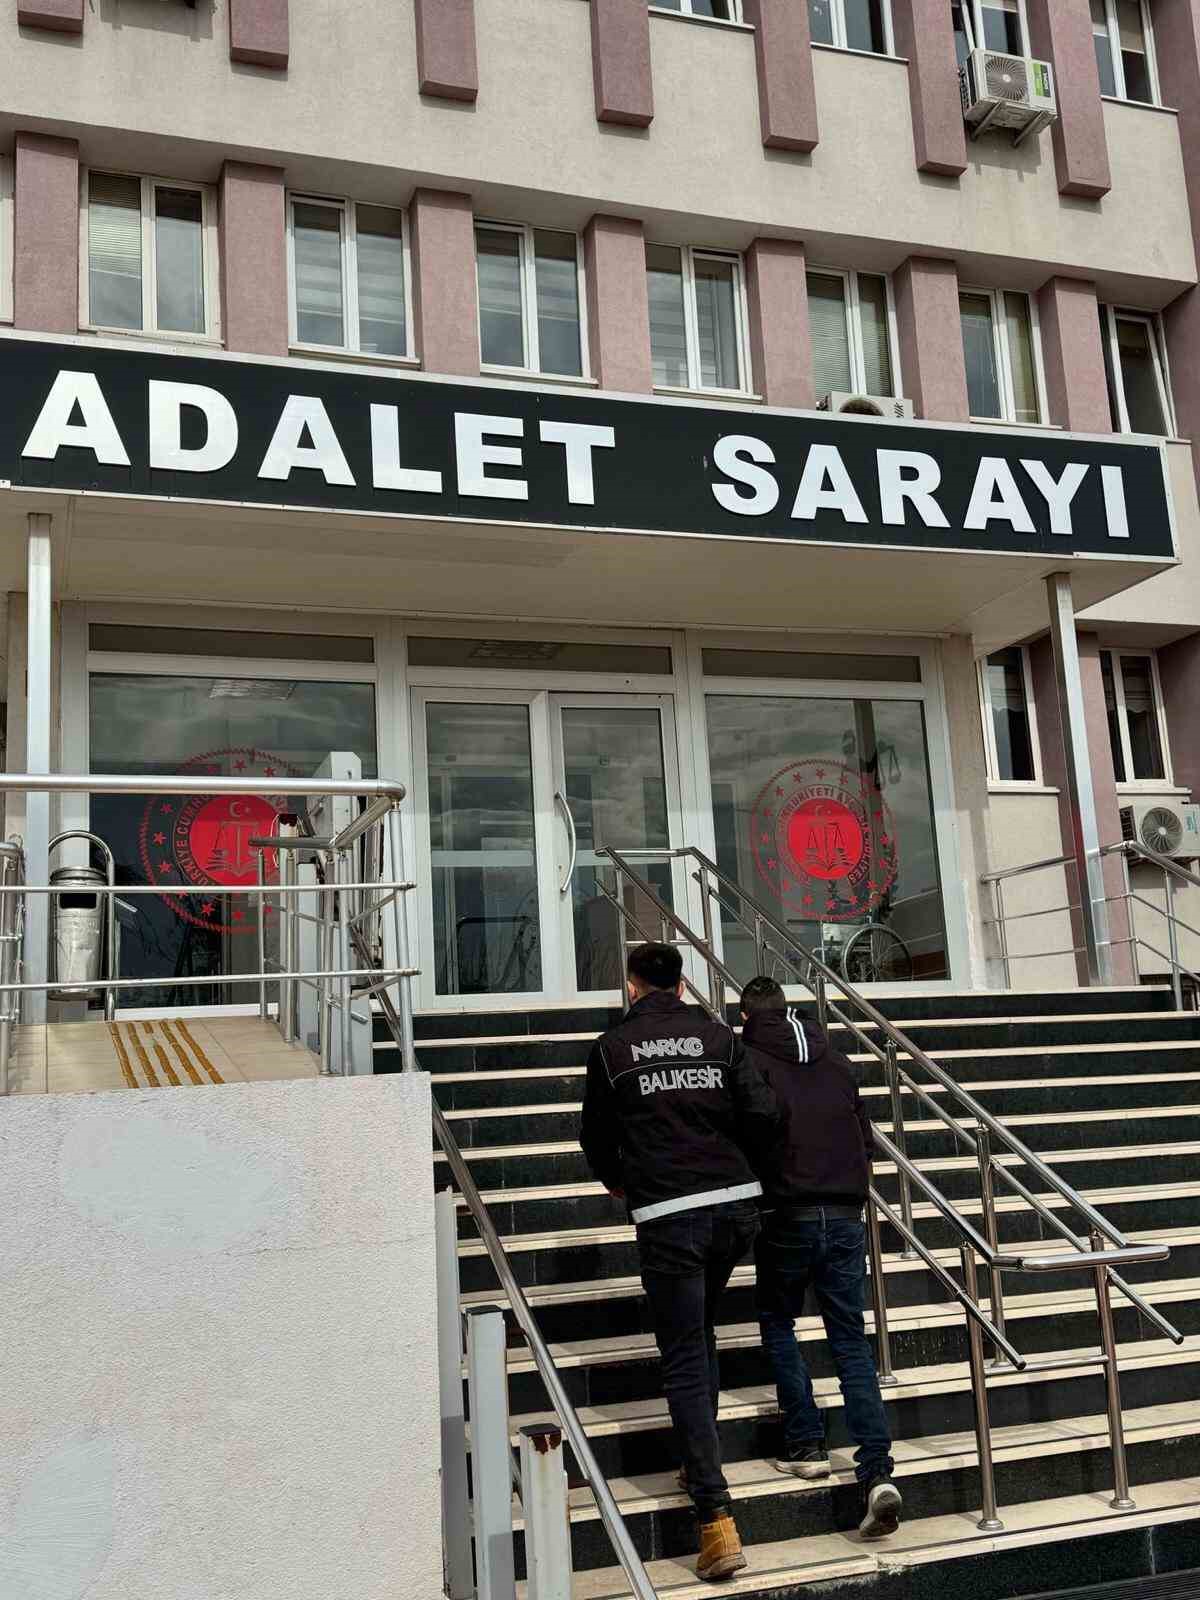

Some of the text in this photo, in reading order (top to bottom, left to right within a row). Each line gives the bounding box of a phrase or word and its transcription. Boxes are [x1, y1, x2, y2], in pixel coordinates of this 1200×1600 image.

[21, 369, 1130, 538] ADALET SARAYI
[630, 1037, 704, 1062] NARKO
[639, 1065, 724, 1096] BALIKESİR
